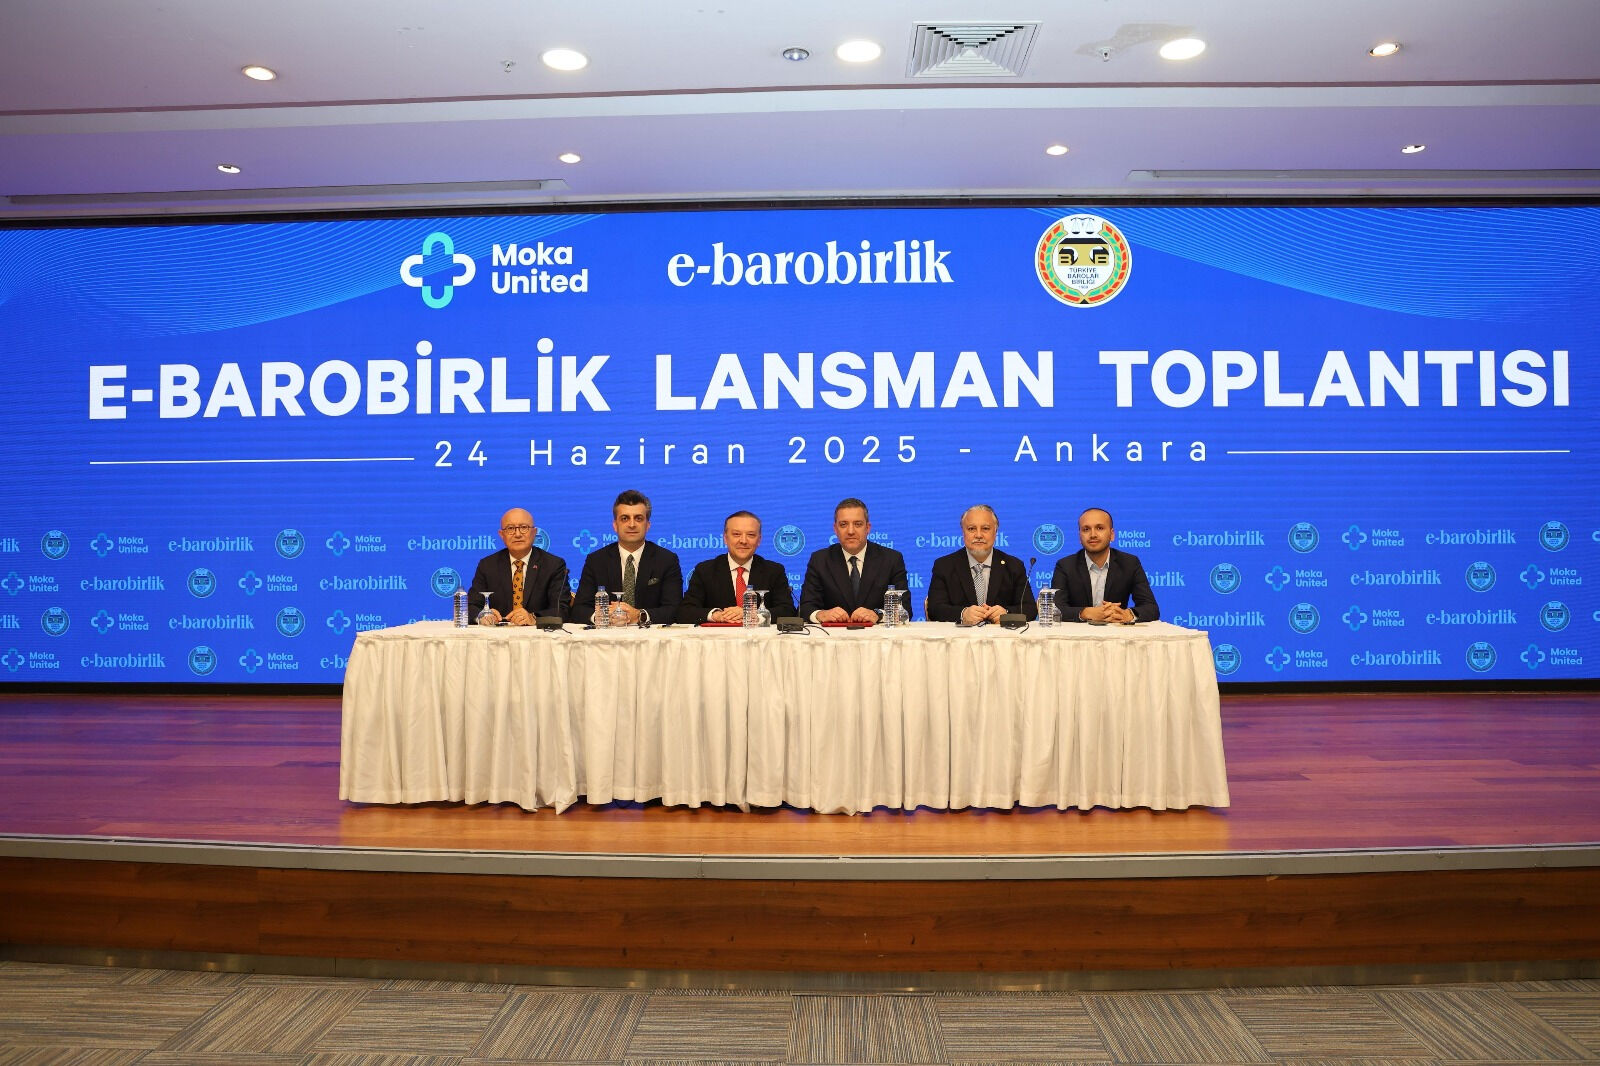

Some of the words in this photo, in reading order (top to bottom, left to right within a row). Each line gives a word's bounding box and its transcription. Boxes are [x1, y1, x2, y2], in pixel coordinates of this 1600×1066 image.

[493, 242, 572, 266] Moka
[668, 240, 954, 286] e-barobirlik
[492, 269, 588, 294] United
[90, 338, 611, 419] E-BAROBİRLİK
[656, 351, 1053, 410] LANSMAN
[1099, 350, 1569, 407] TOPLANTISI
[435, 441, 487, 466] 24
[531, 438, 744, 465] Haziran
[789, 436, 915, 463] 2025
[1014, 434, 1205, 461] Ankara
[1118, 529, 1146, 538] Moka
[1371, 528, 1400, 537] Moka
[118, 535, 144, 544] Moka
[354, 534, 382, 543] Moka
[1172, 531, 1265, 546] e-barobirlik
[1371, 537, 1405, 546] United
[1425, 530, 1517, 545] e-barobirlik
[168, 537, 254, 552] e-barobirlik
[407, 534, 497, 551] e-barobirlik
[1118, 538, 1151, 547] United
[118, 544, 149, 553] United
[354, 543, 387, 552] United
[1295, 569, 1323, 578] Moka
[1549, 567, 1577, 576] Moka
[28, 575, 55, 584] Moka
[266, 574, 293, 583] Moka
[1295, 578, 1328, 587] United
[1350, 570, 1442, 586] e-barobirlik
[1549, 576, 1582, 585] United
[80, 576, 165, 591] e-barobirlik
[266, 583, 298, 592] United
[319, 576, 408, 591] e-barobirlik
[28, 584, 59, 593] United
[1372, 608, 1400, 617] Moka
[118, 613, 144, 622] Moka
[355, 613, 382, 622] Moka
[1372, 617, 1405, 626] United
[1425, 610, 1517, 625] e-barobirlik
[118, 622, 149, 631] United
[168, 615, 255, 630] e-barobirlik
[29, 651, 55, 660] Moka
[1295, 649, 1323, 658] Moka
[1550, 647, 1578, 656] Moka
[80, 653, 166, 668] e-barobirlik
[267, 652, 294, 661] Moka
[1350, 650, 1442, 666] e-barobirlik
[1550, 656, 1583, 665] United
[29, 660, 60, 669] United
[267, 661, 299, 670] United
[1295, 658, 1328, 667] United
